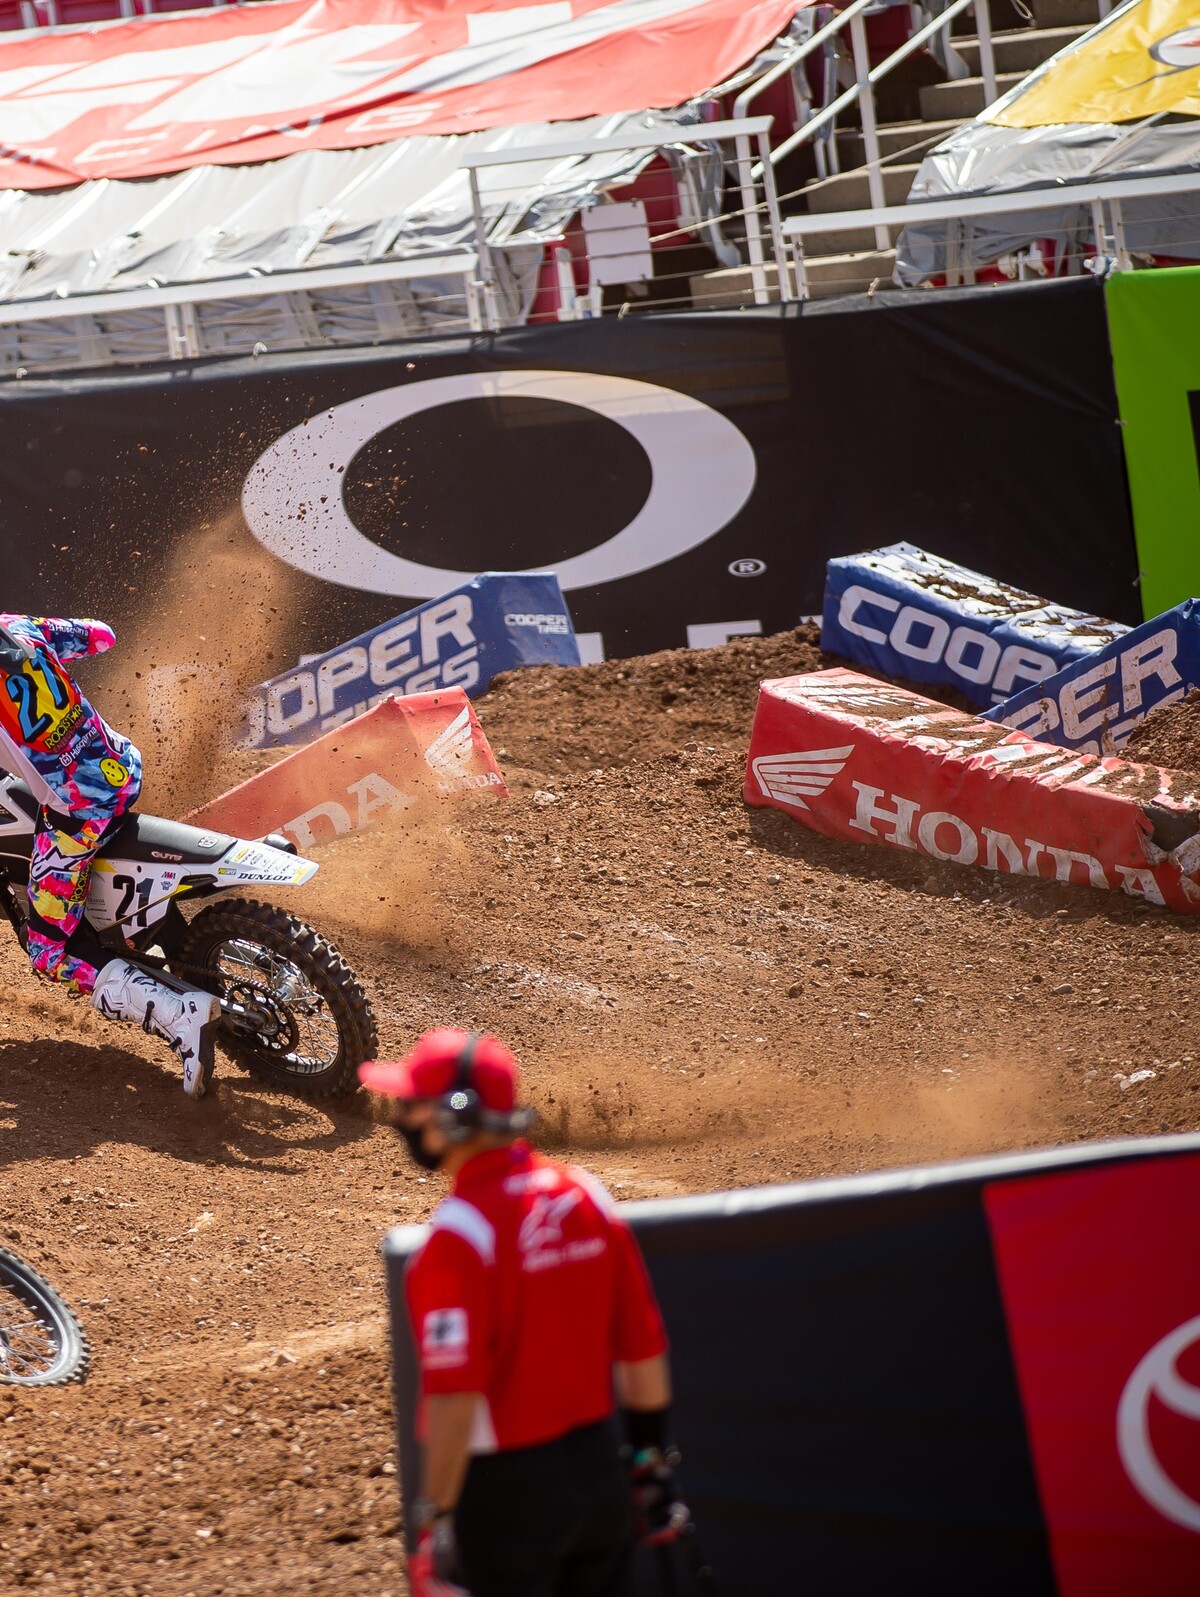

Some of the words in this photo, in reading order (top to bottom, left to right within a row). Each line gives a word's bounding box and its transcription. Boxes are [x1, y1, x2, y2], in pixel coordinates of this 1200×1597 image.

[504, 613, 568, 628] COOPER
[538, 626, 569, 635] TIRES
[838, 584, 1062, 693] COOP
[6, 646, 71, 742] 21
[70, 726, 98, 760] Husqvarna
[150, 850, 184, 861] GUTS
[237, 872, 293, 881] DUNLOP
[112, 874, 155, 928] 21
